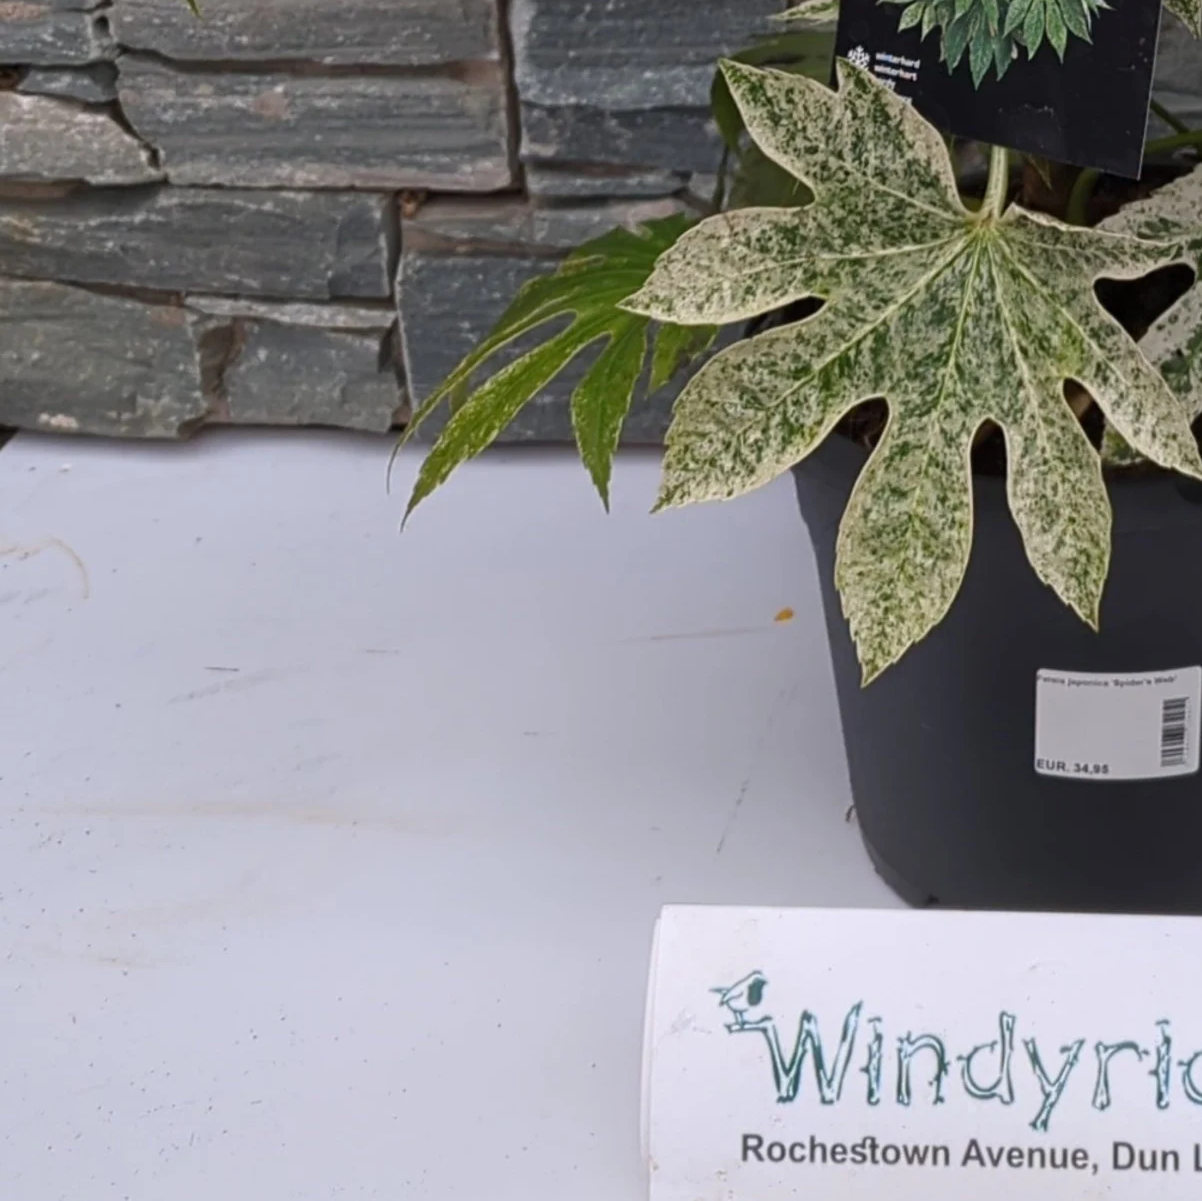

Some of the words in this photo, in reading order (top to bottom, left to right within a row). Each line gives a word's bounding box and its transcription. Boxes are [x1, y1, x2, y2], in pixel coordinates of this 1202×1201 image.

[1037, 759, 1069, 772] EUR.
[742, 1134, 950, 1166] Rochestown
[962, 1139, 1097, 1174] Avenue,
[1113, 1142, 1179, 1171] Dun
